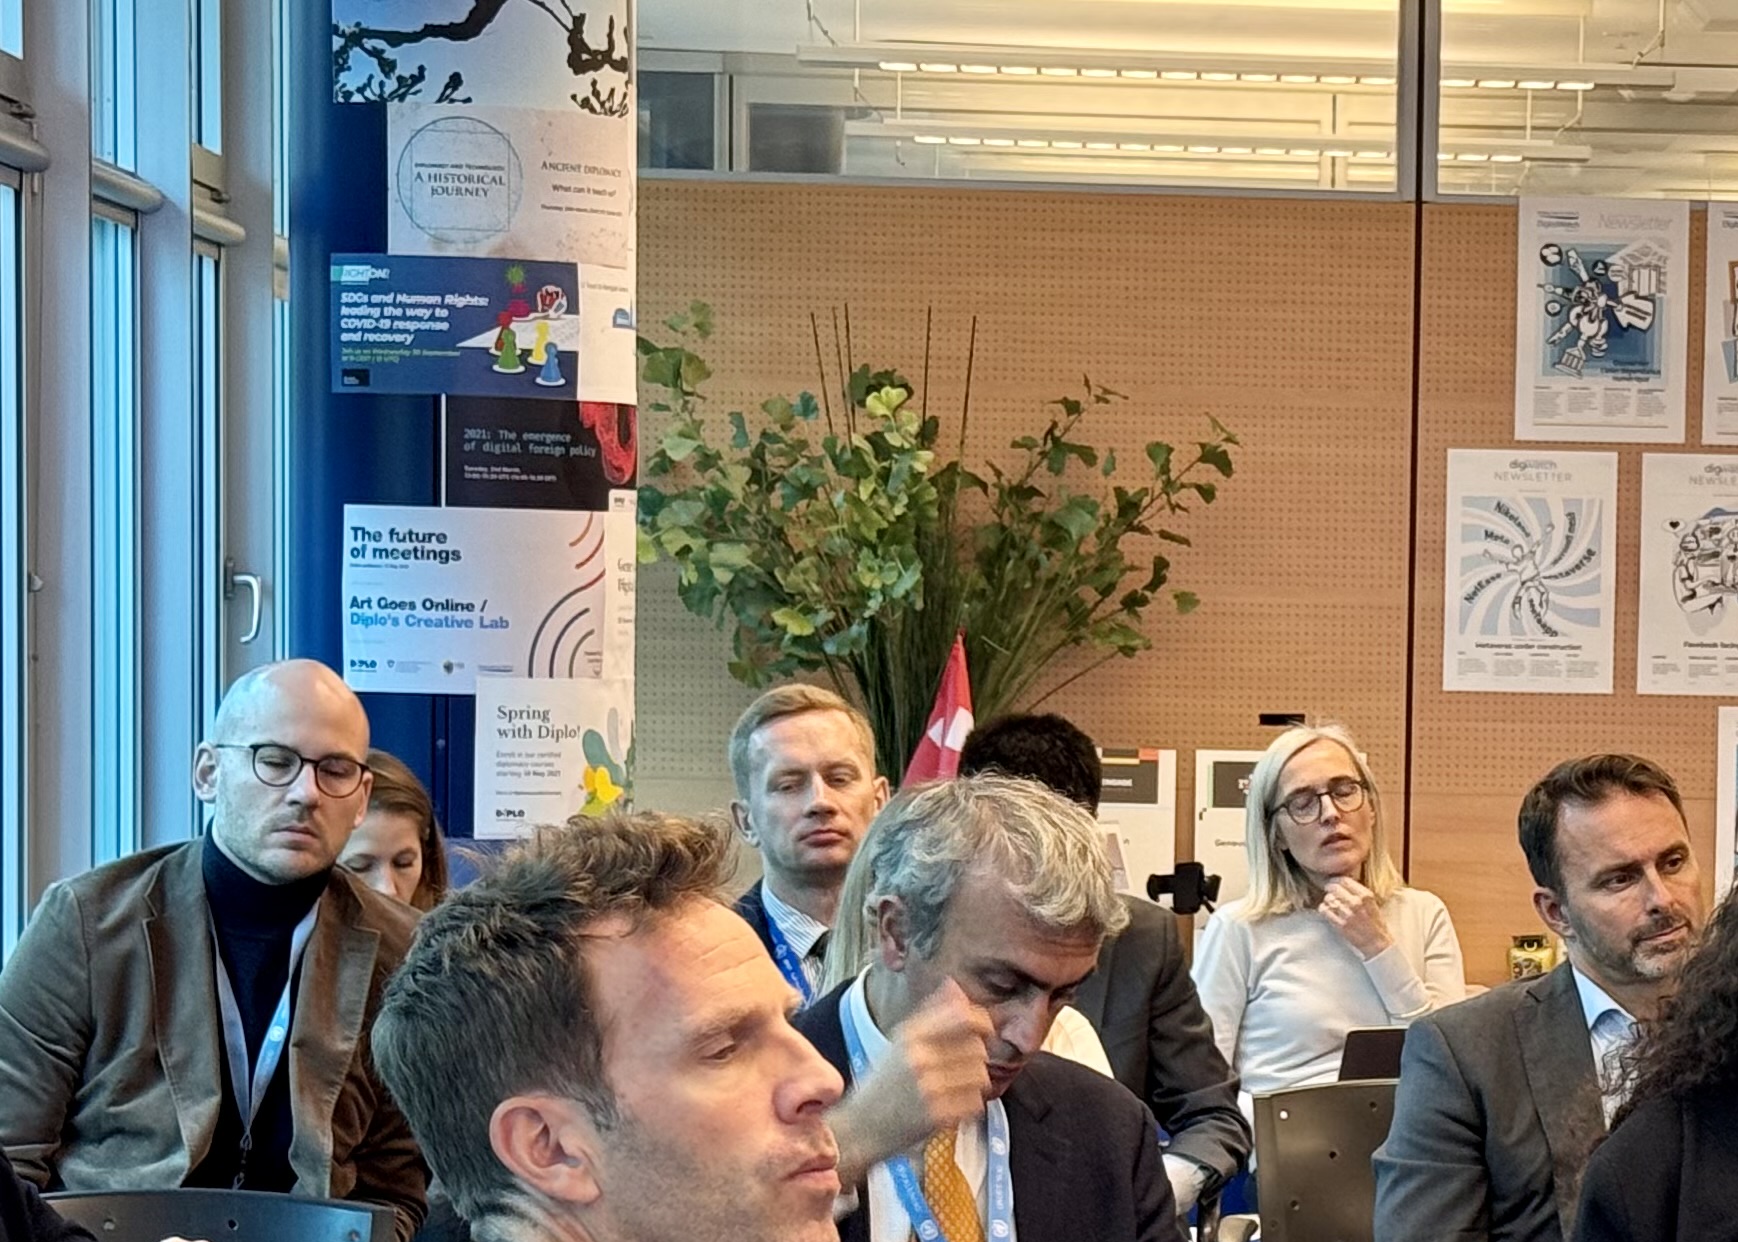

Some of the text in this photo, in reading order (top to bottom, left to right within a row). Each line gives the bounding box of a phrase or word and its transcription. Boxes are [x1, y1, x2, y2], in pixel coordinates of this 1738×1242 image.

[541, 160, 582, 172] ANCIENT
[414, 171, 506, 186] A HISTORICAL
[431, 185, 490, 198] JOURNEY
[552, 184, 572, 193] What
[1600, 213, 1673, 232] Newsletter
[340, 292, 368, 304] SDGs
[371, 292, 394, 304] and
[396, 293, 442, 305] Human
[340, 305, 449, 320] leading the way to
[340, 318, 450, 332] COVID-19 response
[340, 332, 414, 346] and recovery
[464, 428, 572, 444] 2021: The emergence
[464, 441, 597, 458] of digital foreign policy
[1494, 472, 1572, 482] NEWSLETTER
[350, 526, 448, 544] The future
[1484, 529, 1510, 545] Meta
[350, 544, 462, 564] of meetings
[349, 596, 373, 610] Art
[377, 596, 417, 610] Goes
[422, 598, 476, 612] Online
[350, 612, 510, 630] Diplo's Creative Lab
[496, 705, 551, 723] Spring
[496, 724, 581, 743] with Diplo!
